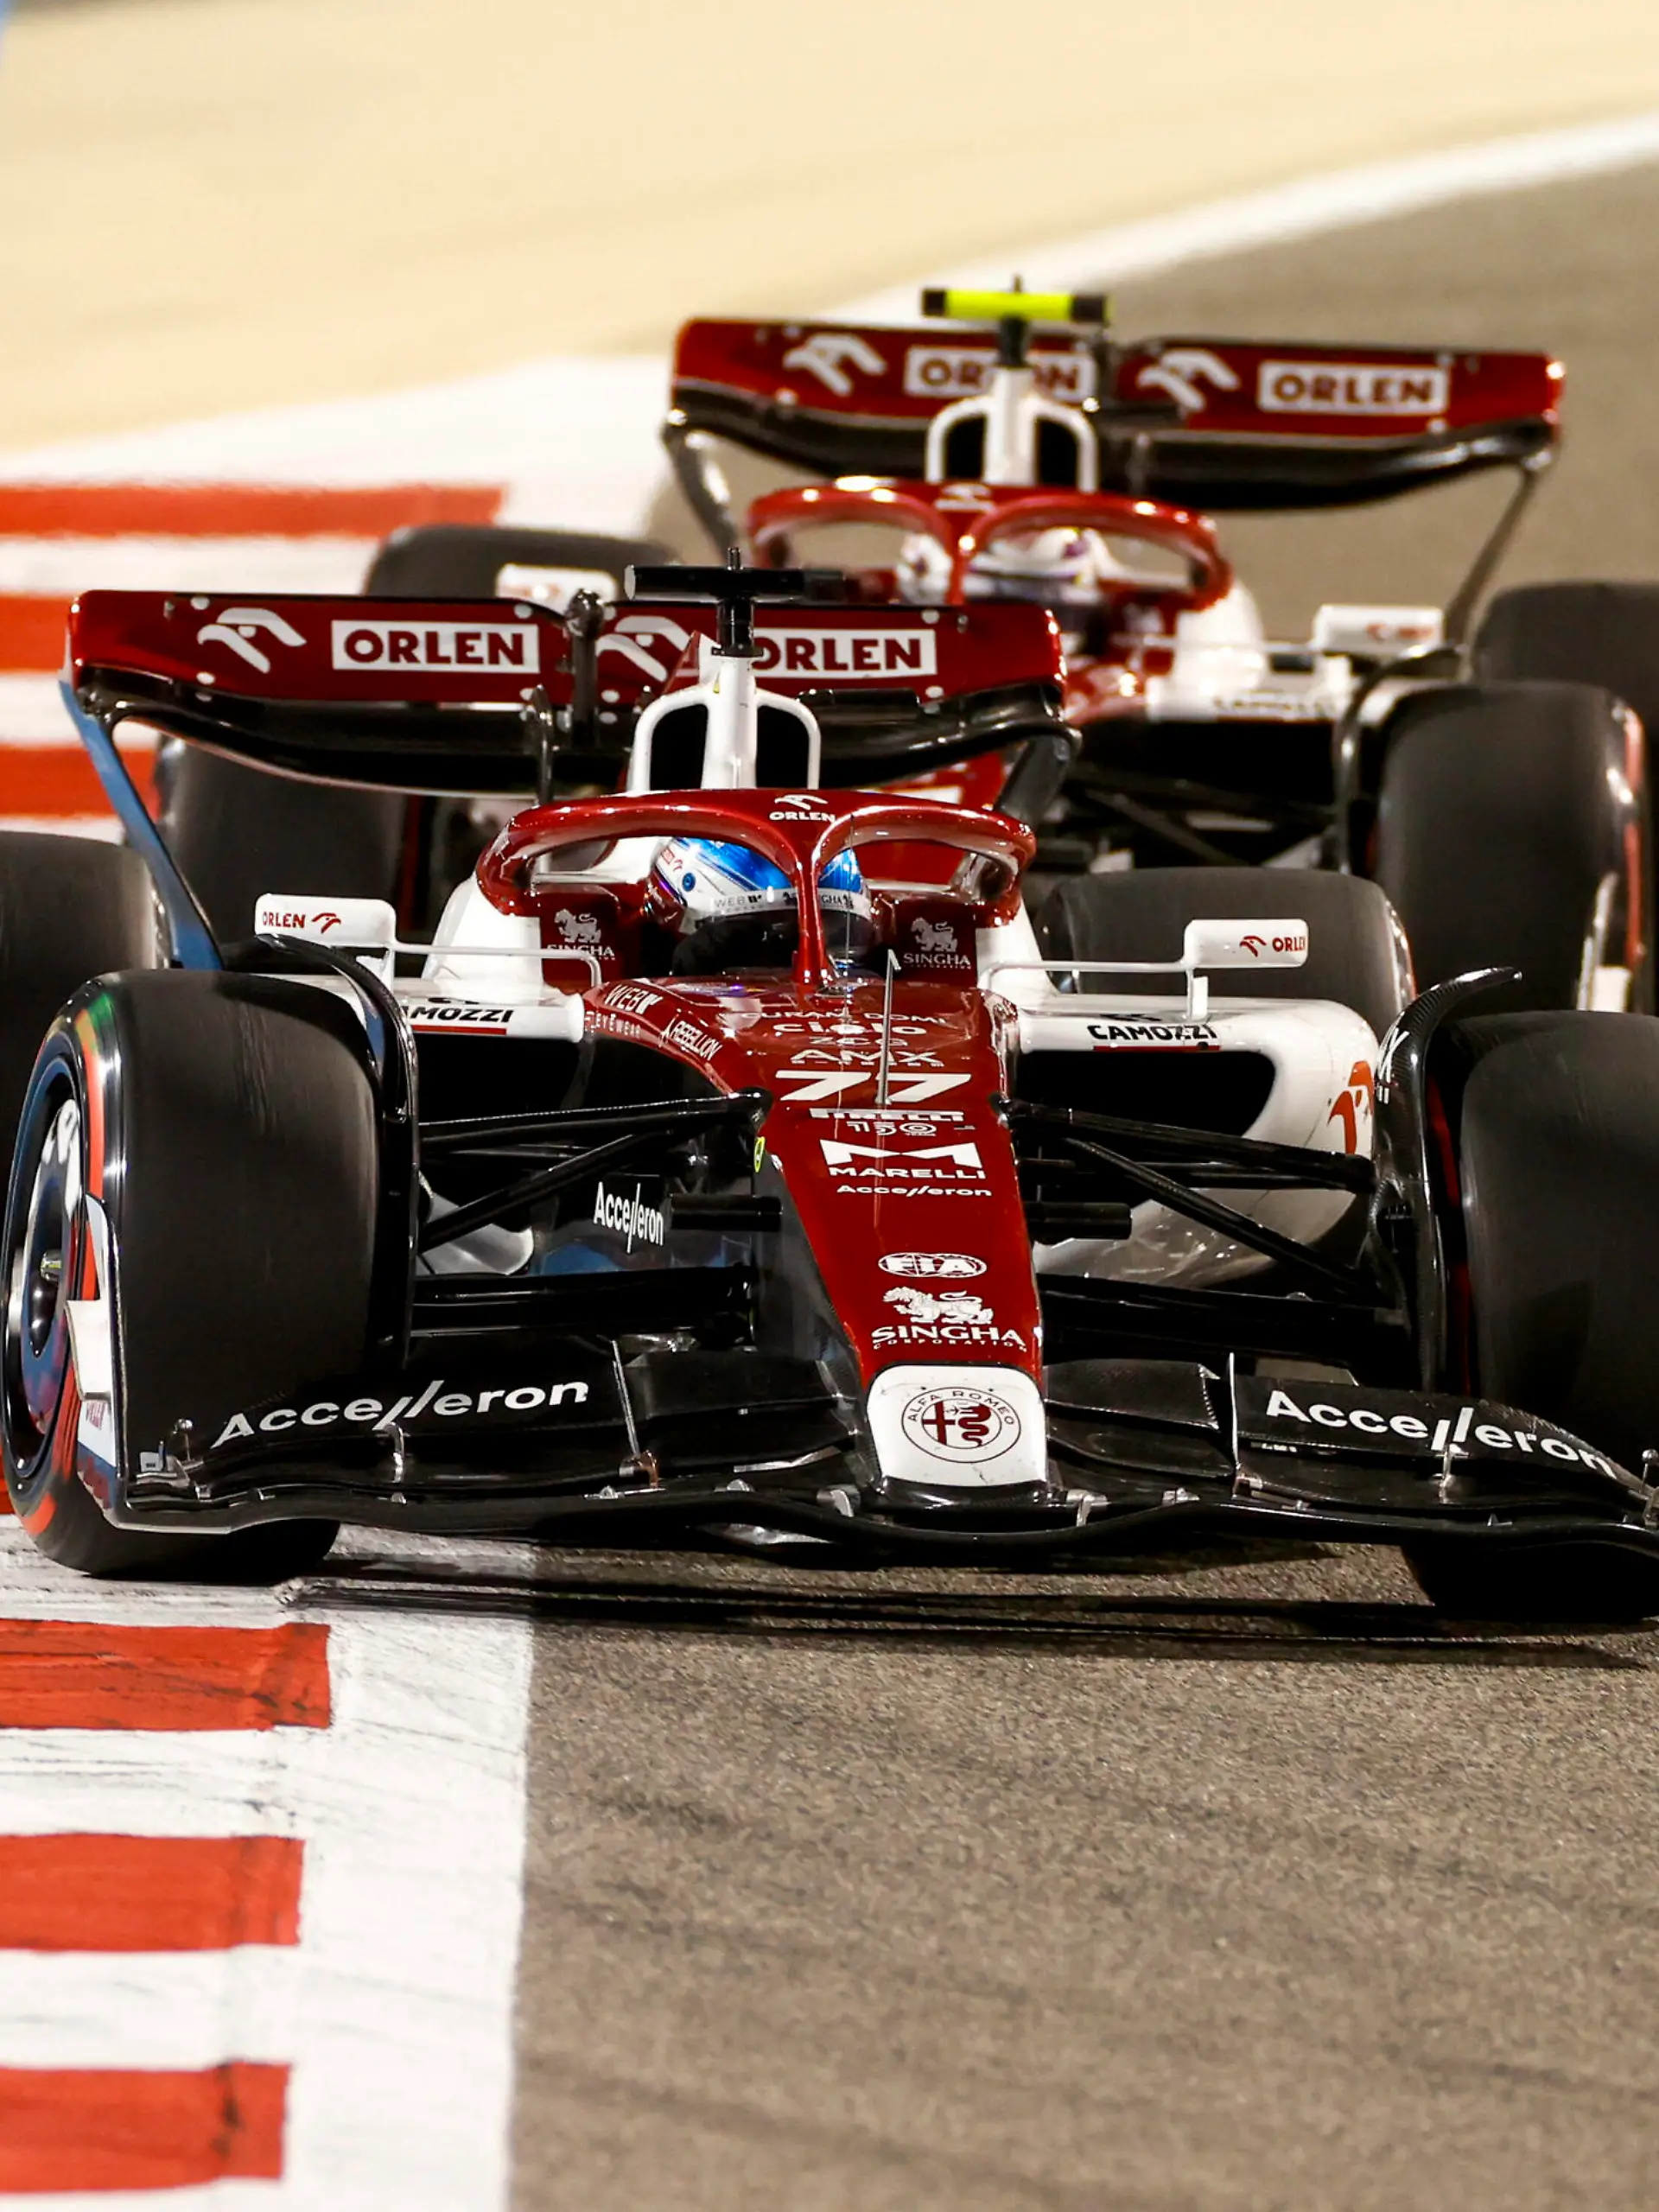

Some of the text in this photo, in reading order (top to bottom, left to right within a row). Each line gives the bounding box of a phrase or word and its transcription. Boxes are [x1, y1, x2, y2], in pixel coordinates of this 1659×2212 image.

[920, 359, 1078, 391] ORN
[1272, 374, 1434, 404] ORLEN
[343, 629, 524, 666] ORLEN
[752, 636, 921, 671] ORLEN
[769, 810, 836, 822] ORLEN
[263, 912, 306, 928] ORLEN
[1272, 937, 1306, 952] ORLE
[903, 952, 971, 965] SINGHA
[604, 985, 648, 1012] WEB
[402, 1006, 514, 1023] MOZZI
[1087, 1024, 1218, 1040] CAMOZZI
[790, 1049, 940, 1064] AMX
[775, 1071, 971, 1103] 77
[828, 1166, 986, 1179] MARELLI
[593, 1181, 664, 1254] Accelleron
[885, 1255, 978, 1274] FIA
[871, 1325, 1027, 1346] SINGHA
[873, 1338, 1027, 1353] CORPORATION
[210, 1380, 589, 1450] Accelleron
[907, 1390, 1014, 1425] ALFA ROMEO
